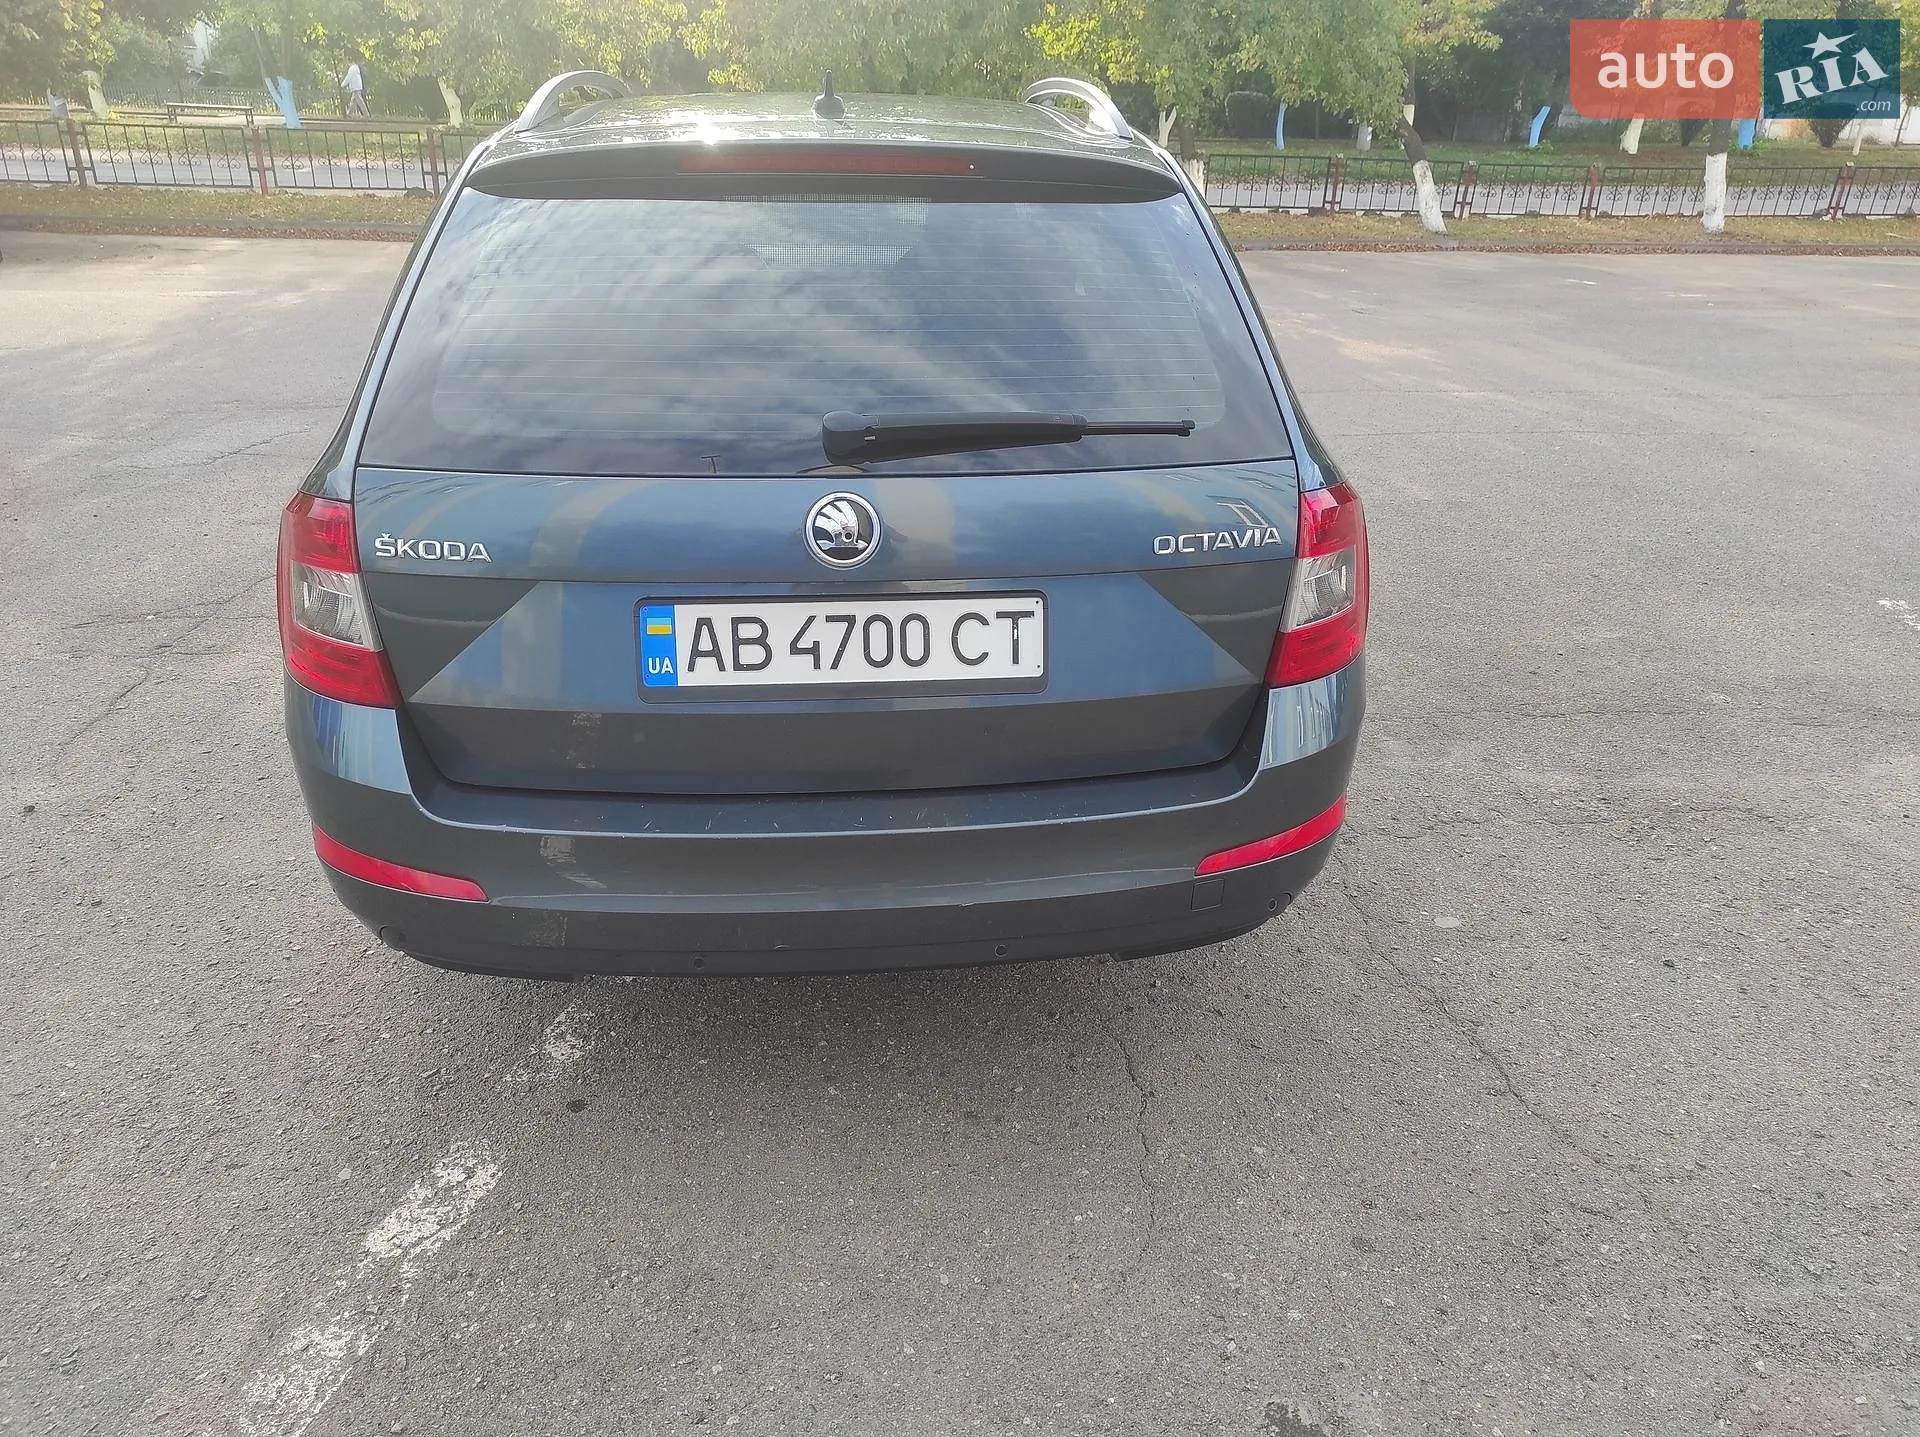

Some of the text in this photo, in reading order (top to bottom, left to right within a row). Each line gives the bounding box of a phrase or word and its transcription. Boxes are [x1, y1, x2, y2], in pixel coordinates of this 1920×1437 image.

[374, 532, 493, 563] ŠKODA
[1153, 527, 1283, 556] OCTAVIA
[686, 610, 1035, 673] AB 4700 CT
[648, 656, 675, 675] UA
